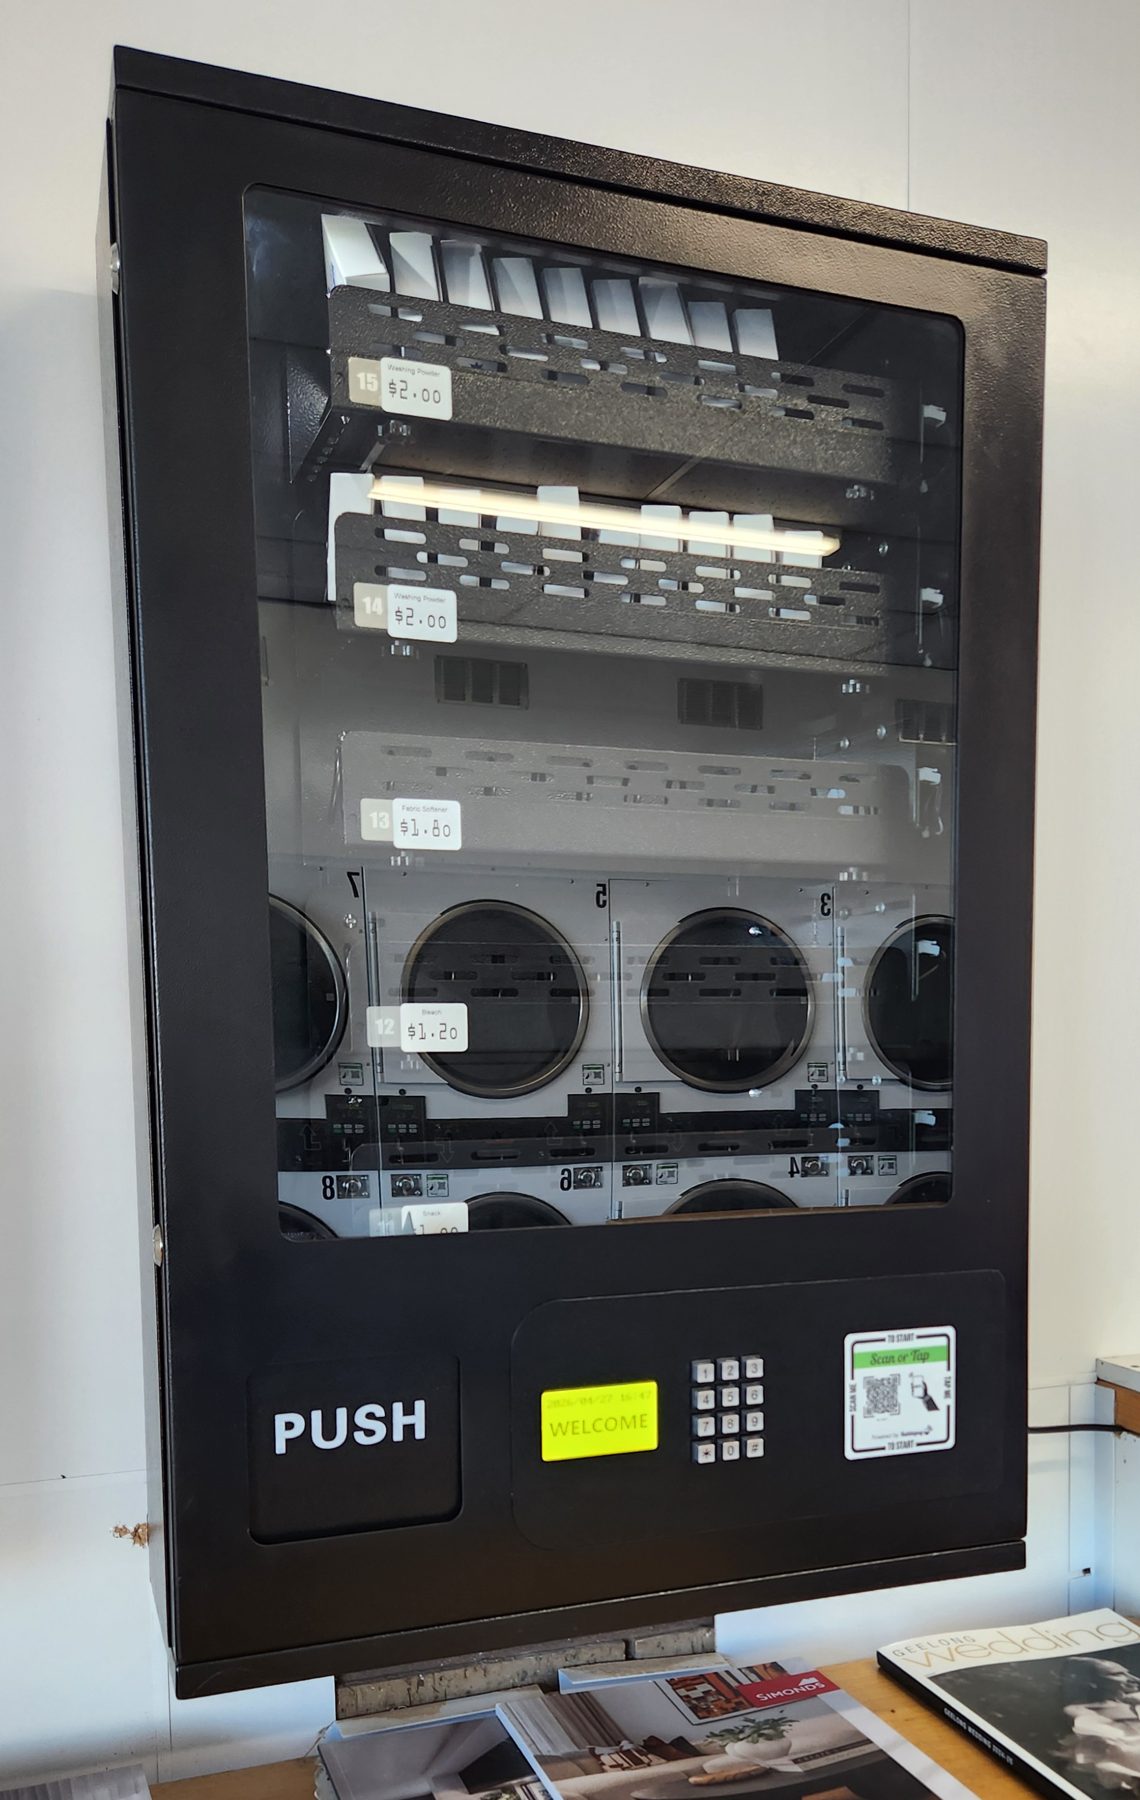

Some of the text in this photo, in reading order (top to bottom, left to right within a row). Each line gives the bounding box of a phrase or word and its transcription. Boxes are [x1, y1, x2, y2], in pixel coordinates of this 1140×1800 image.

[388, 364, 441, 376] Washing Powder
[356, 372, 379, 392] 15
[389, 379, 441, 404] $2.00
[362, 596, 384, 616] 14
[394, 592, 421, 602] Washing
[395, 606, 447, 629] $2.00
[402, 804, 421, 812] Fabric
[369, 811, 390, 830] 13
[400, 818, 451, 837] $1.80
[374, 1018, 395, 1036] 12
[408, 1023, 457, 1040] $1.20
[888, 1333, 914, 1343] TO START
[870, 1349, 930, 1366] Scan or Tap
[727, 1365, 734, 1376] 2
[751, 1363, 758, 1374] 3
[703, 1390, 758, 1405] 4 5 6
[849, 1394, 857, 1412] SCAN
[274, 1399, 426, 1455] PUSH
[549, 1413, 649, 1437] WELCOME
[703, 1416, 758, 1432] 7 8 9
[727, 1445, 734, 1456] 0
[888, 1440, 914, 1450] TO START
[892, 1635, 956, 1657] GEELONG
[902, 1621, 1140, 1668] wedding
[756, 1683, 825, 1701] SIMONDS
[944, 1707, 967, 1730] GEELONG
